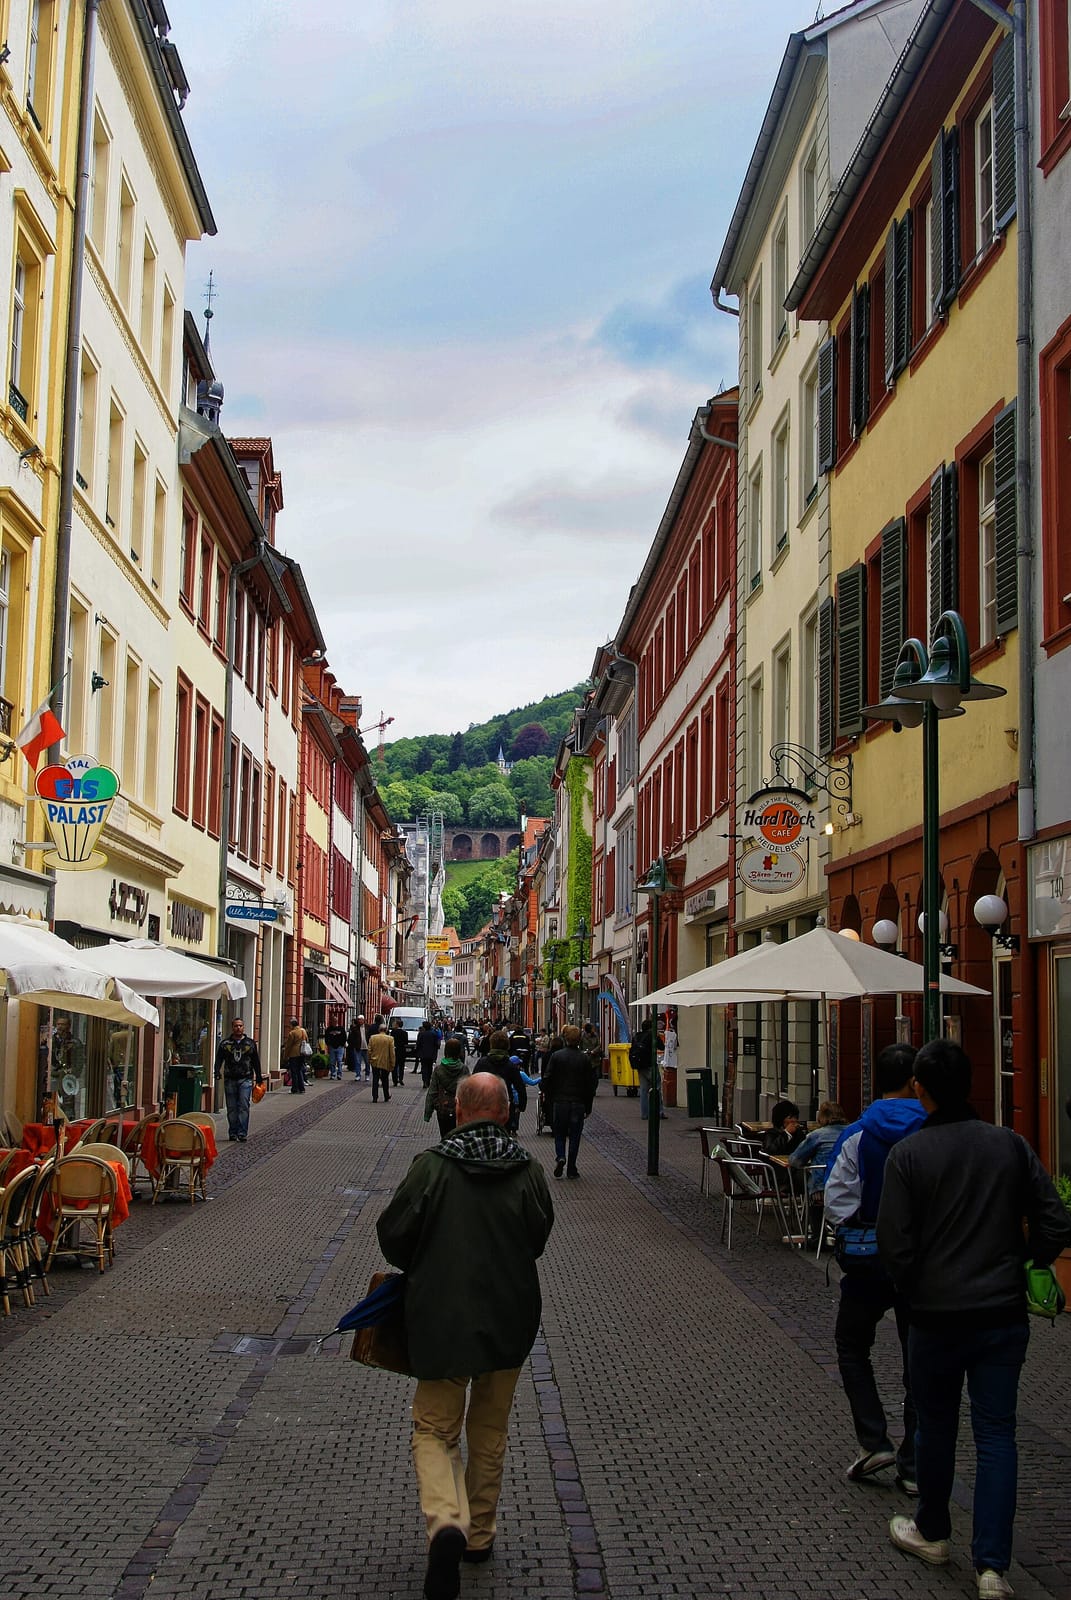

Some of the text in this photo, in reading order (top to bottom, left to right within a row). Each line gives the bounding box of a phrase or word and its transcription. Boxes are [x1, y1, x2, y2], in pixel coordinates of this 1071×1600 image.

[67, 760, 90, 770] ITAL
[54, 778, 100, 799] EIS
[47, 803, 108, 824] PALAST
[743, 809, 815, 829] Hard Rock
[757, 836, 805, 853] HEIDELBERG
[1050, 876, 1064, 899] 140
